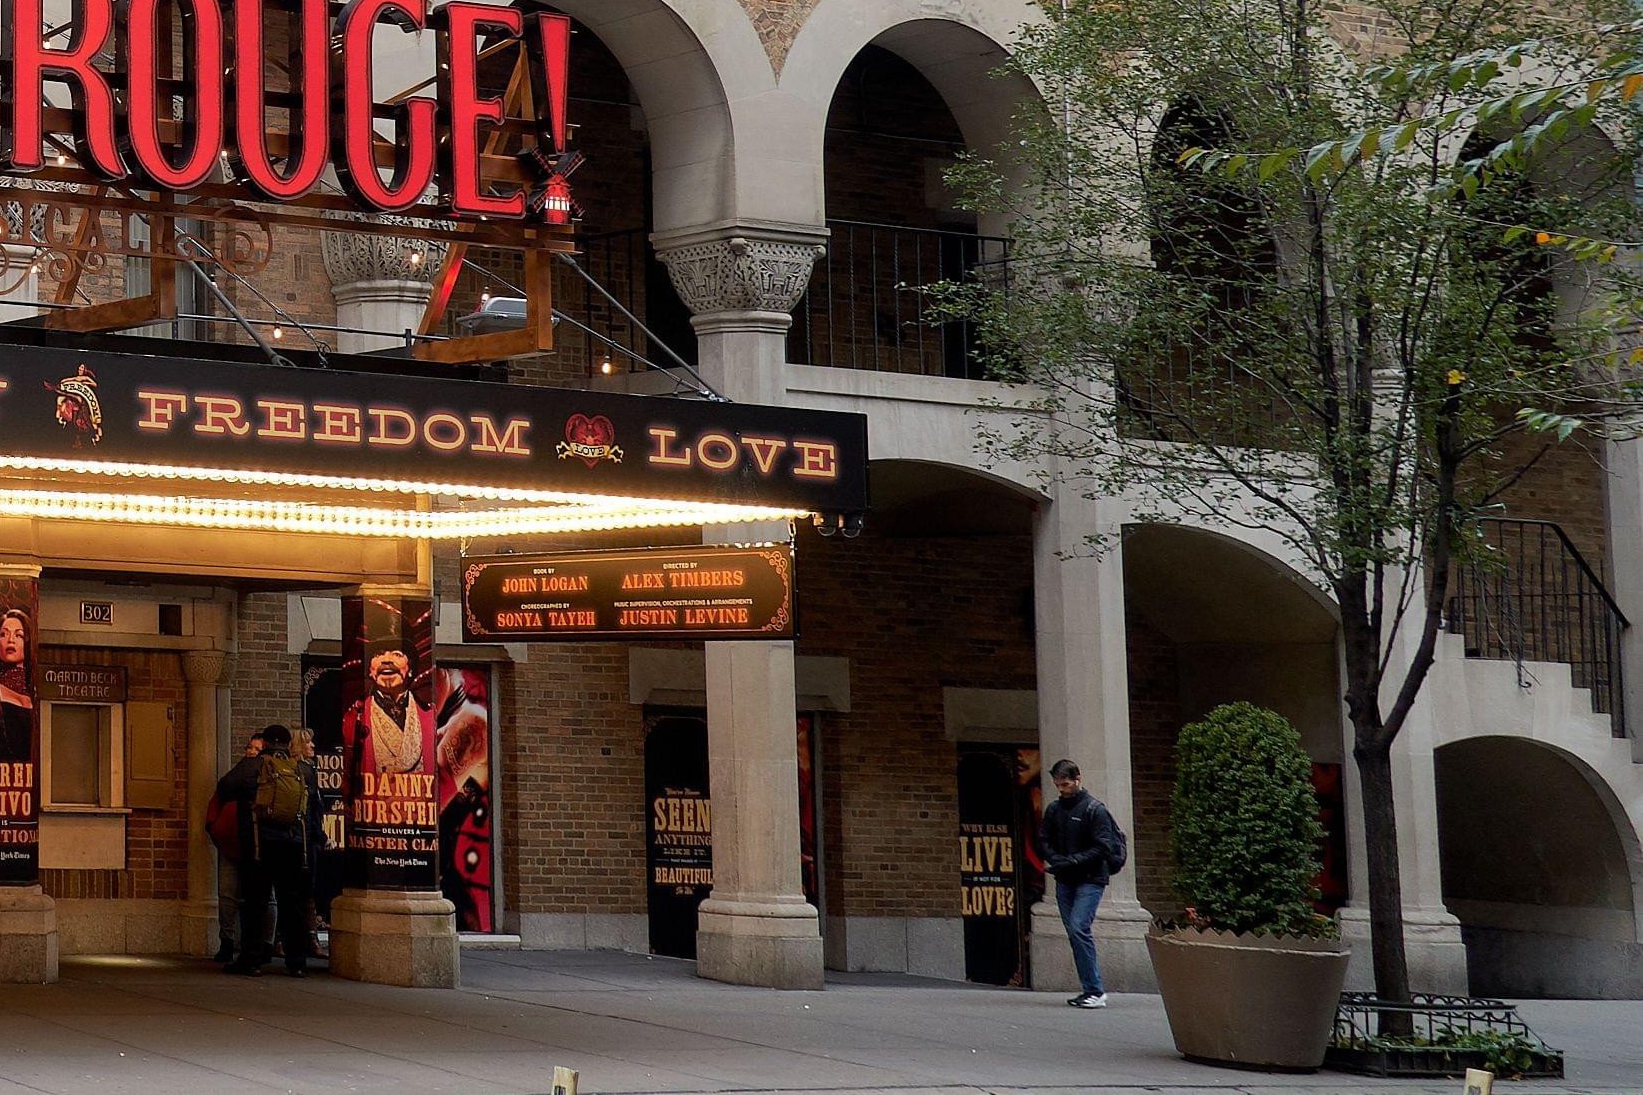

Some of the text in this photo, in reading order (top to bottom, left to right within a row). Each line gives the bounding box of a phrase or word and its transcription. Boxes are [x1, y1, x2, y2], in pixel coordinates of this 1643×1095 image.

[138, 389, 532, 456] FREEDOM
[648, 426, 839, 479] LOVE
[573, 444, 605, 457] LOVE
[502, 576, 588, 594] JOHN LOGAN
[621, 570, 744, 590] ALEX TIMBERS
[85, 605, 110, 621] 302
[497, 611, 596, 627] SONYA TAYEH
[620, 608, 749, 625] JUSTIN LEVINE
[45, 670, 118, 685] MARTIN BECK
[58, 684, 111, 697] THEATRE
[654, 797, 711, 833] SEEN
[382, 827, 415, 835] DELIVERS
[348, 835, 439, 851] MASTER CLA
[654, 834, 712, 846] ANYTHING
[0, 851, 14, 861] York
[14, 851, 31, 860] Times
[663, 847, 691, 855] LIKE
[959, 836, 1014, 873] LIVE
[374, 857, 386, 866] The
[386, 857, 399, 866] New
[655, 867, 714, 885] BEAUTIFUL
